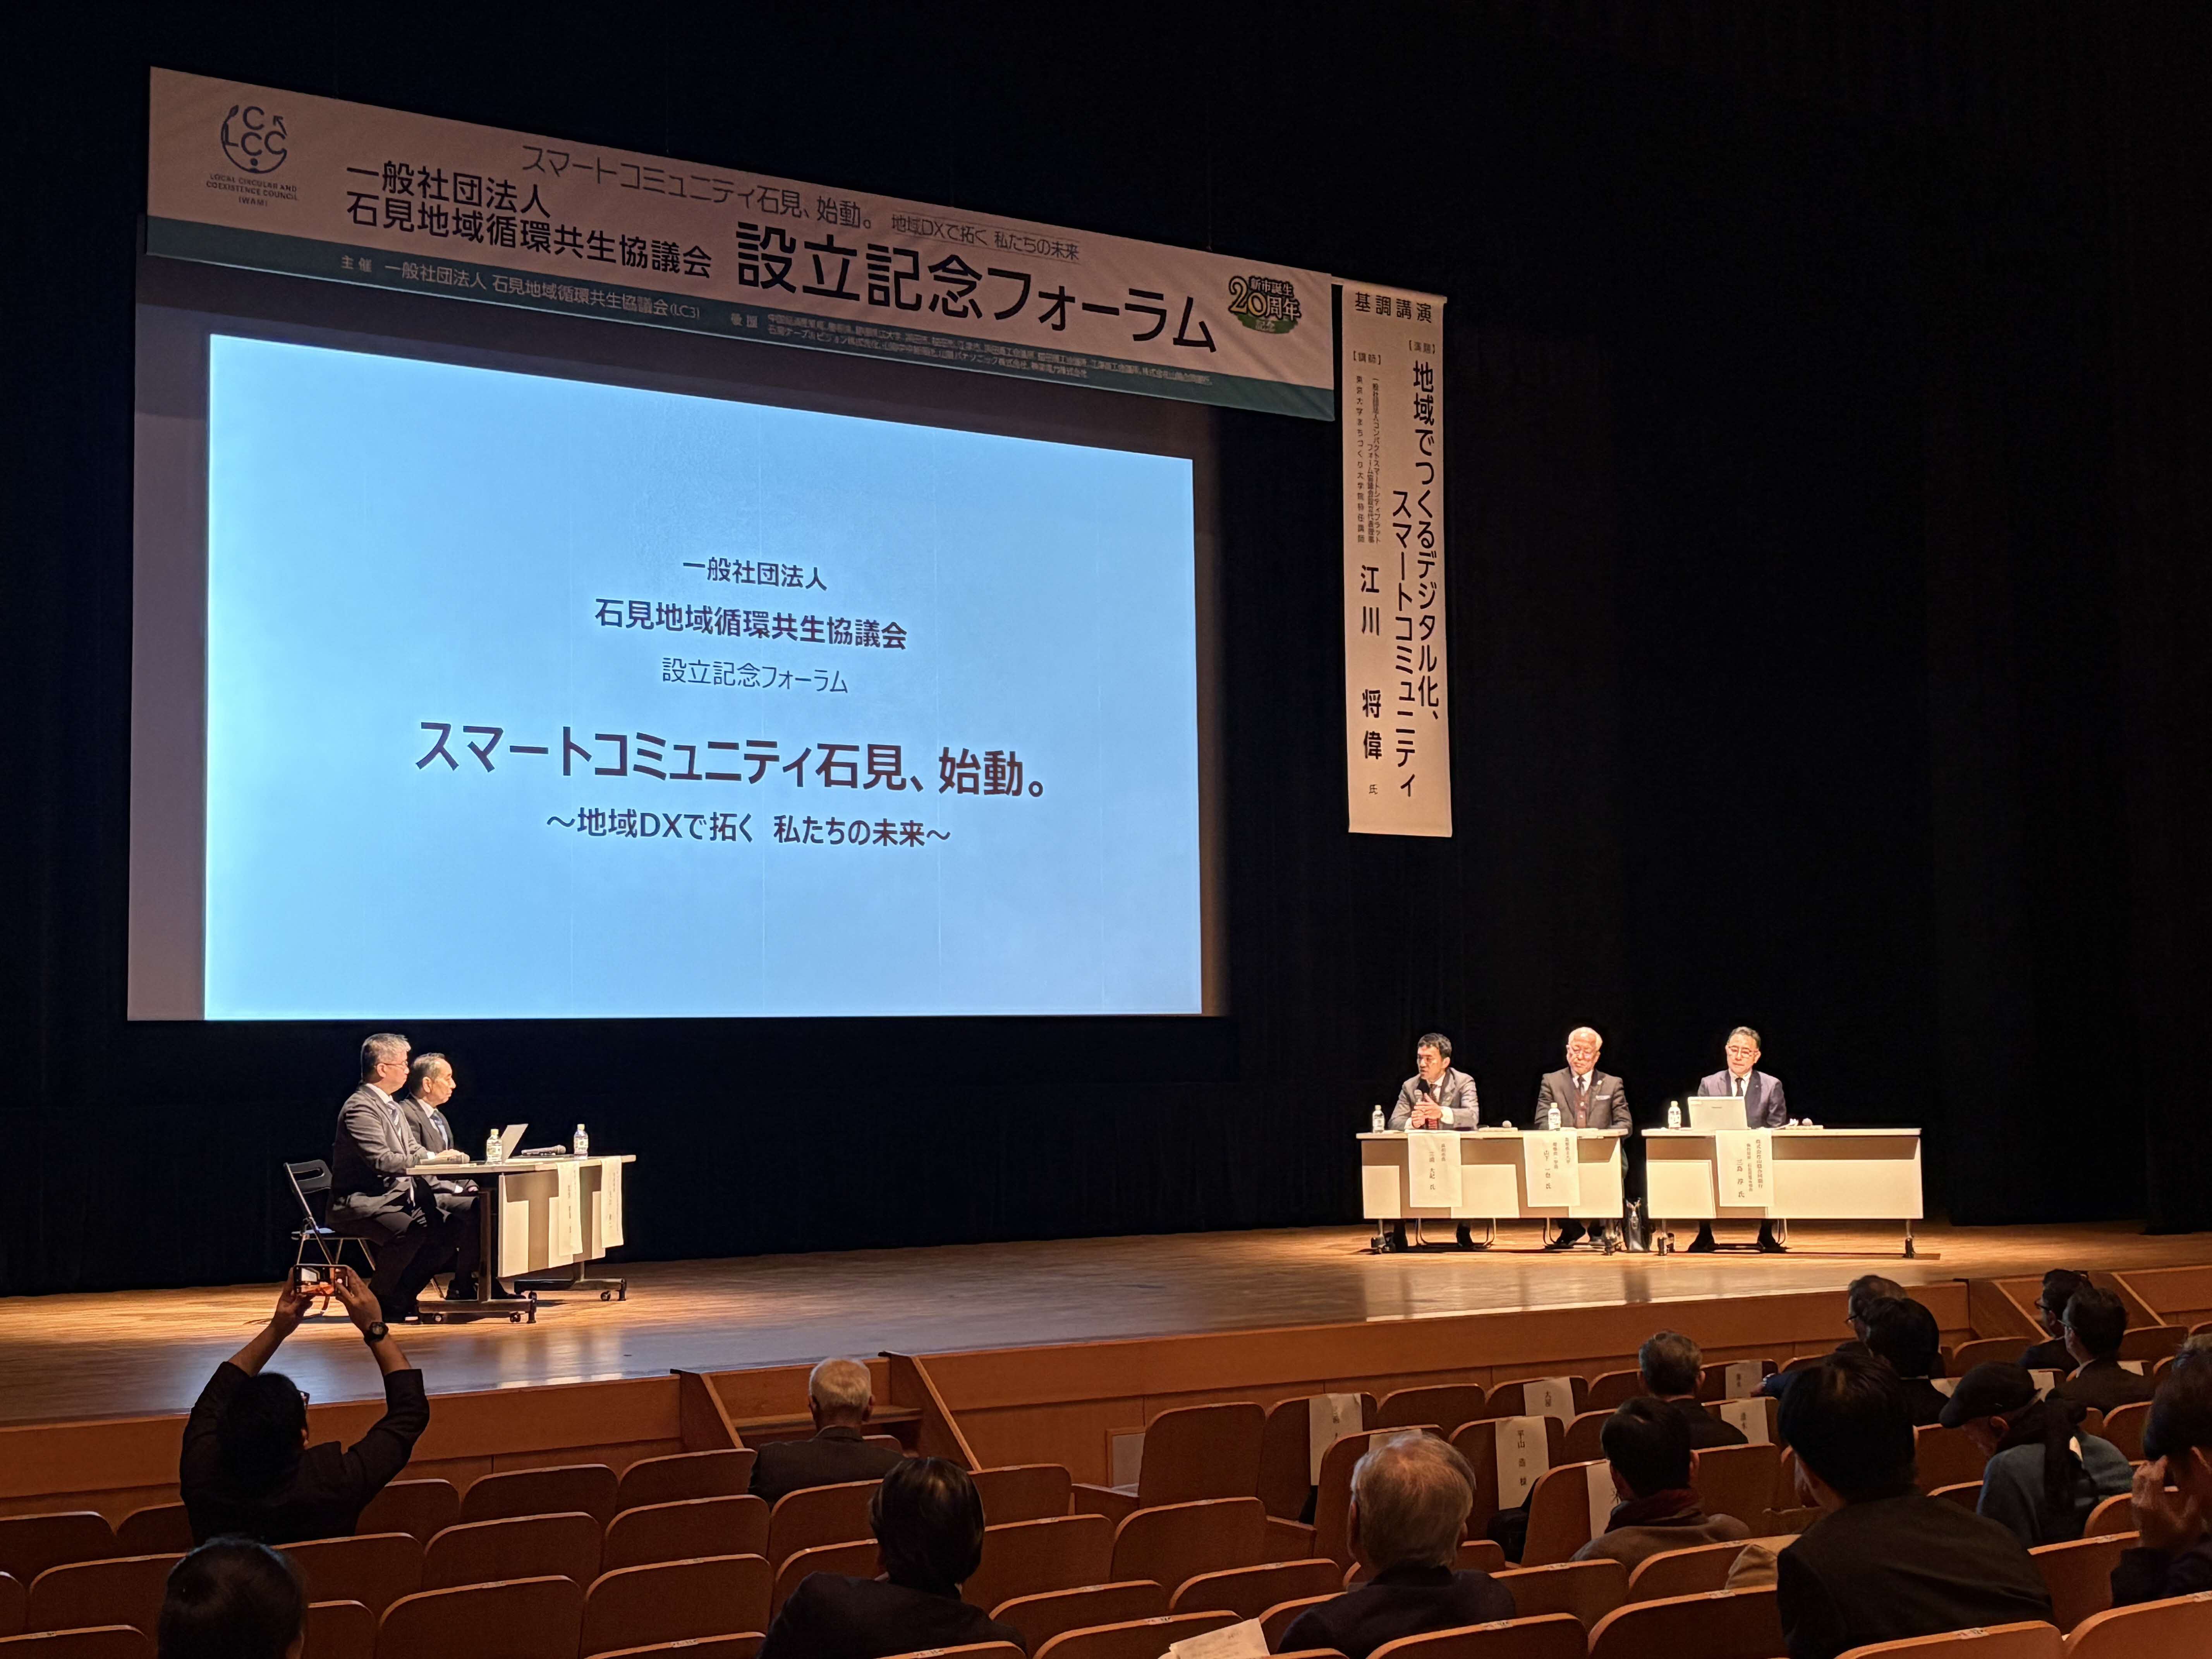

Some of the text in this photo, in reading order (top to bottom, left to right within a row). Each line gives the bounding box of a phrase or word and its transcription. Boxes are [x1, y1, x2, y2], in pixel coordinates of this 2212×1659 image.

[206, 180, 298, 201] COEXISTENCE COUNCIL
[210, 173, 236, 184] LOCAL
[238, 177, 278, 190] CIRCULAR
[347, 160, 551, 218] 一般社団法人
[523, 145, 872, 229] スマートコミュニティ石見、始動。
[347, 191, 712, 279] 石見地域循環共生協議会
[891, 213, 1080, 261] 地域DXで拓く 私たちの未来
[384, 261, 487, 292] 一般社団法人
[736, 221, 1217, 353] 設立記念フォーラム
[1355, 291, 1432, 324] 基調講演
[1412, 360, 1439, 720] 地域でつくるデジタル化、
[683, 556, 827, 591] 一般社団法人
[595, 598, 907, 650] 石見地域循環共生協議会
[1392, 490, 1416, 797] スマートコミュニティ
[662, 658, 848, 694] 設立記念フォーラム
[1360, 564, 1382, 795] 江川 将偉 氏
[416, 722, 1043, 797] スマートコミュニティ石見、始動。
